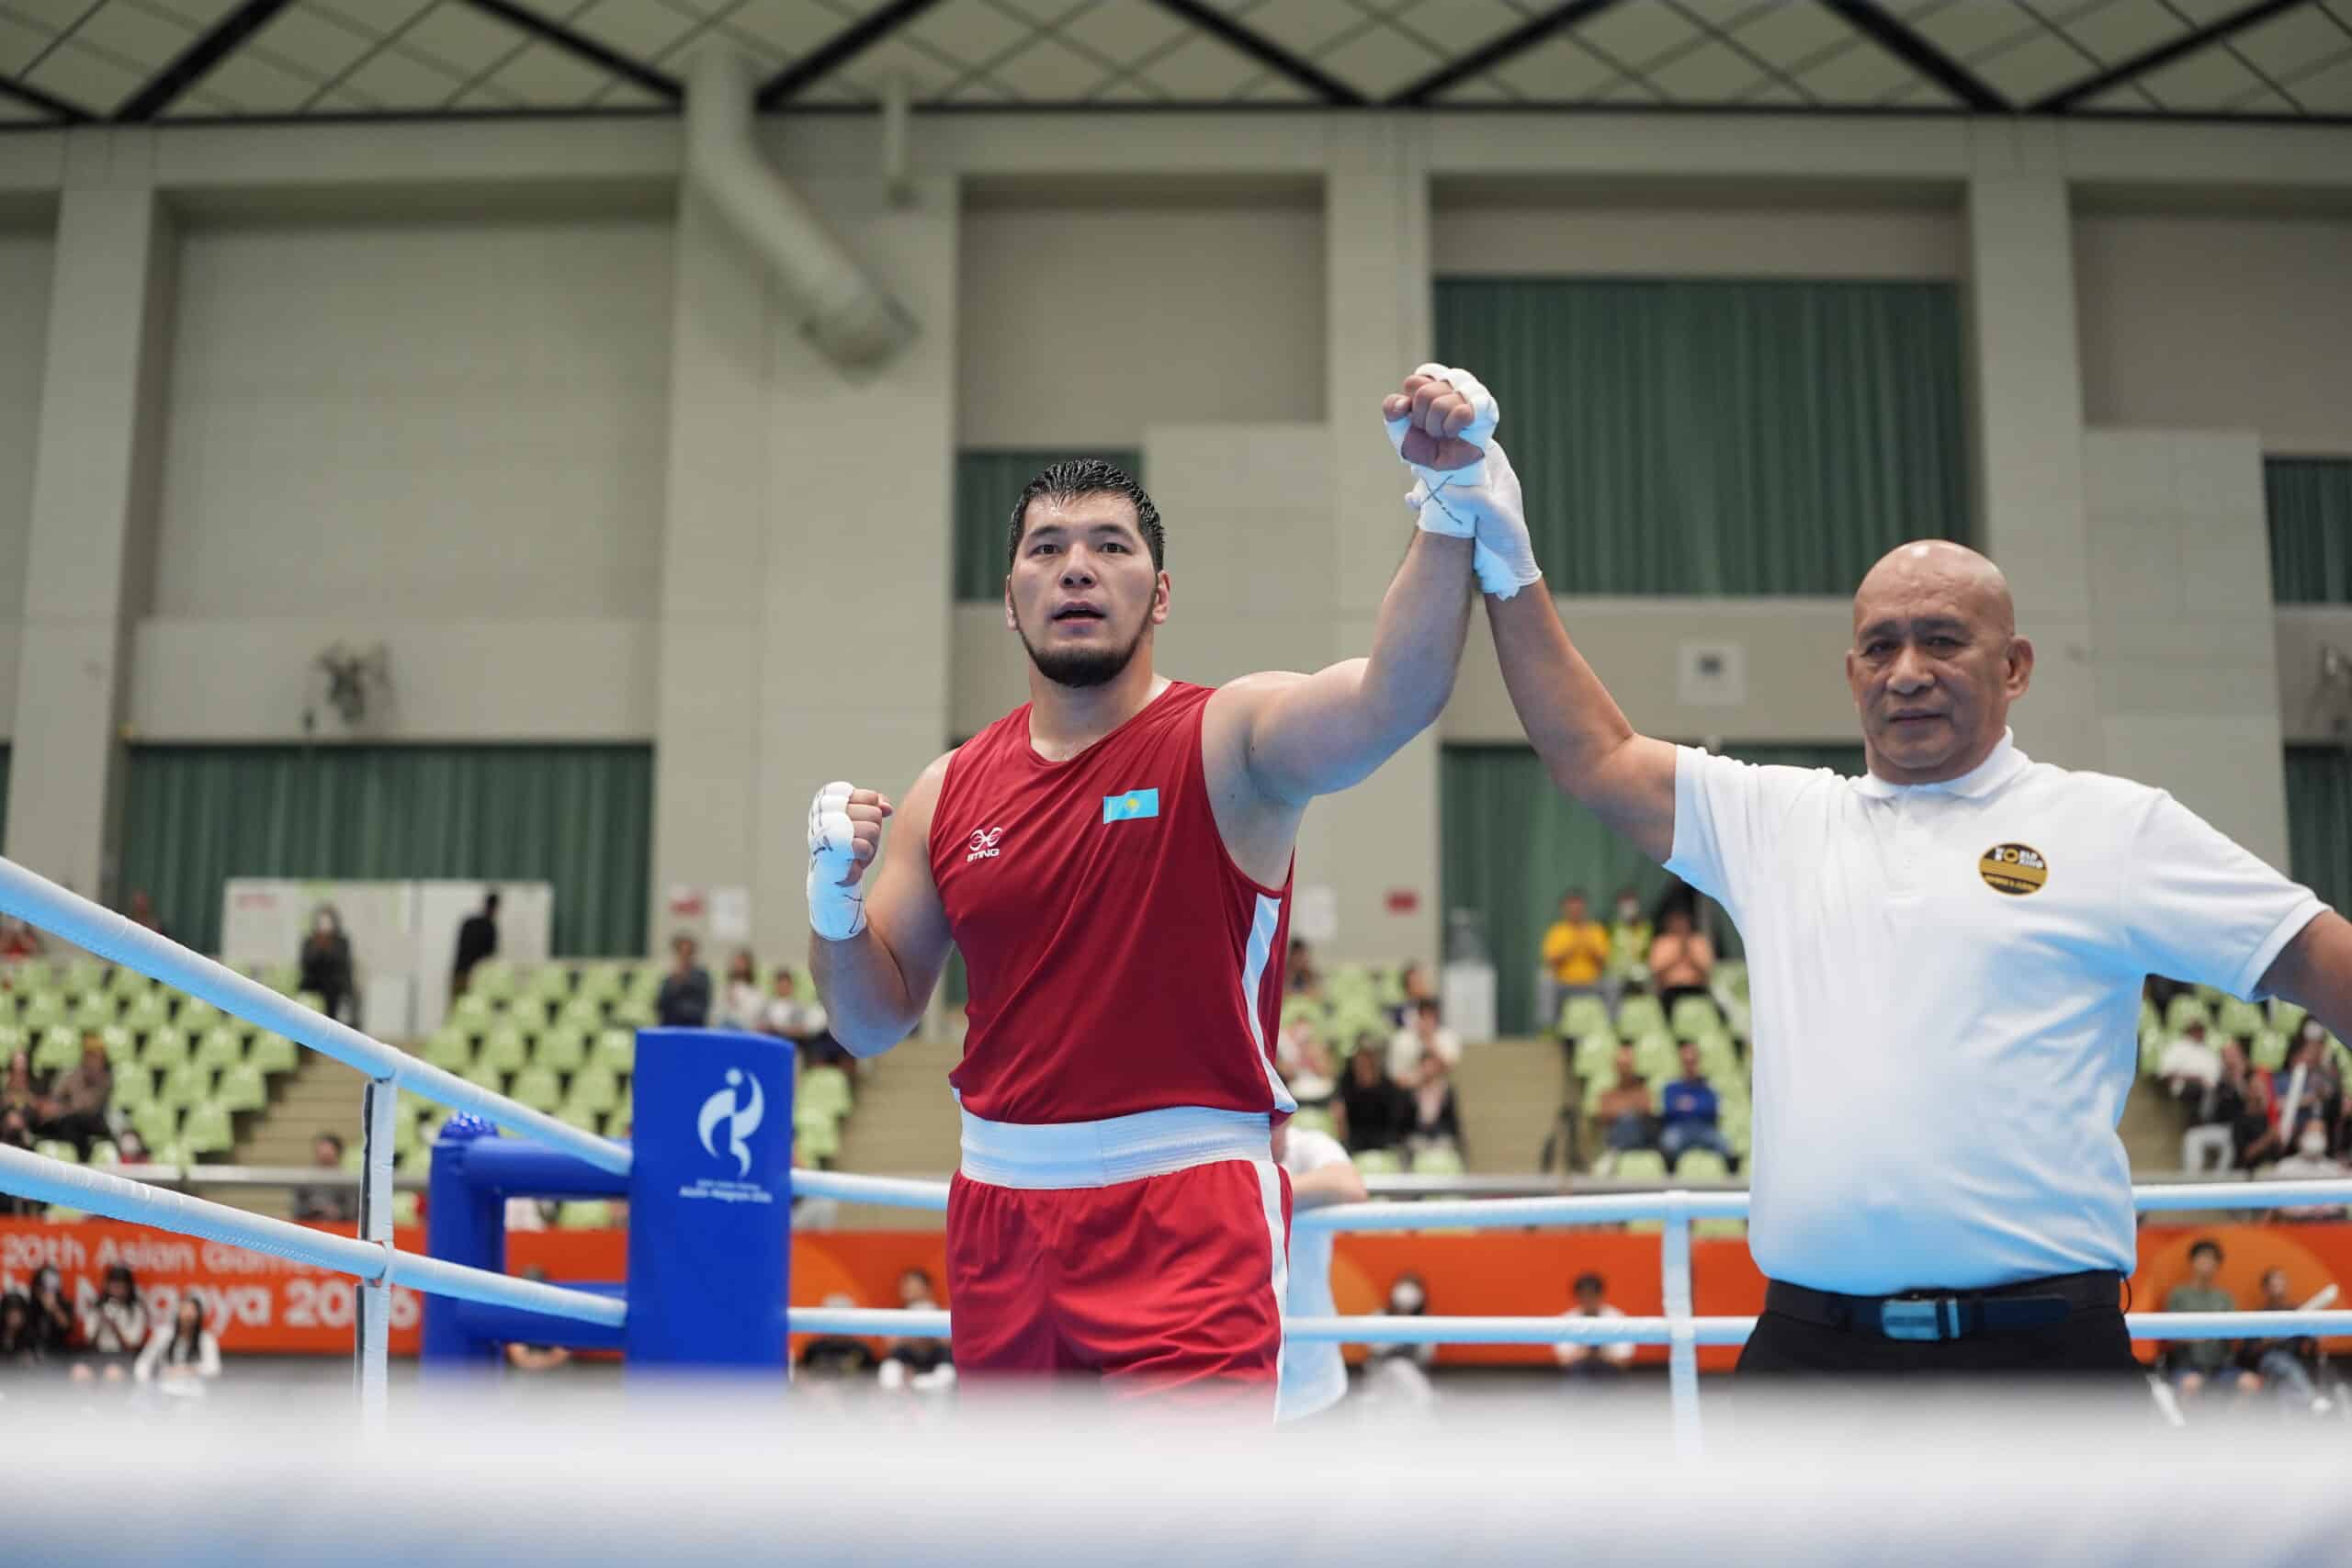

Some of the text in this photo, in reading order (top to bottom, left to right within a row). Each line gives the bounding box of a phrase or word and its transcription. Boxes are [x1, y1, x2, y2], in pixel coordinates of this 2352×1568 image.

[3, 1234, 338, 1276] 20th Asian Gam
[283, 1278, 421, 1329] 206
